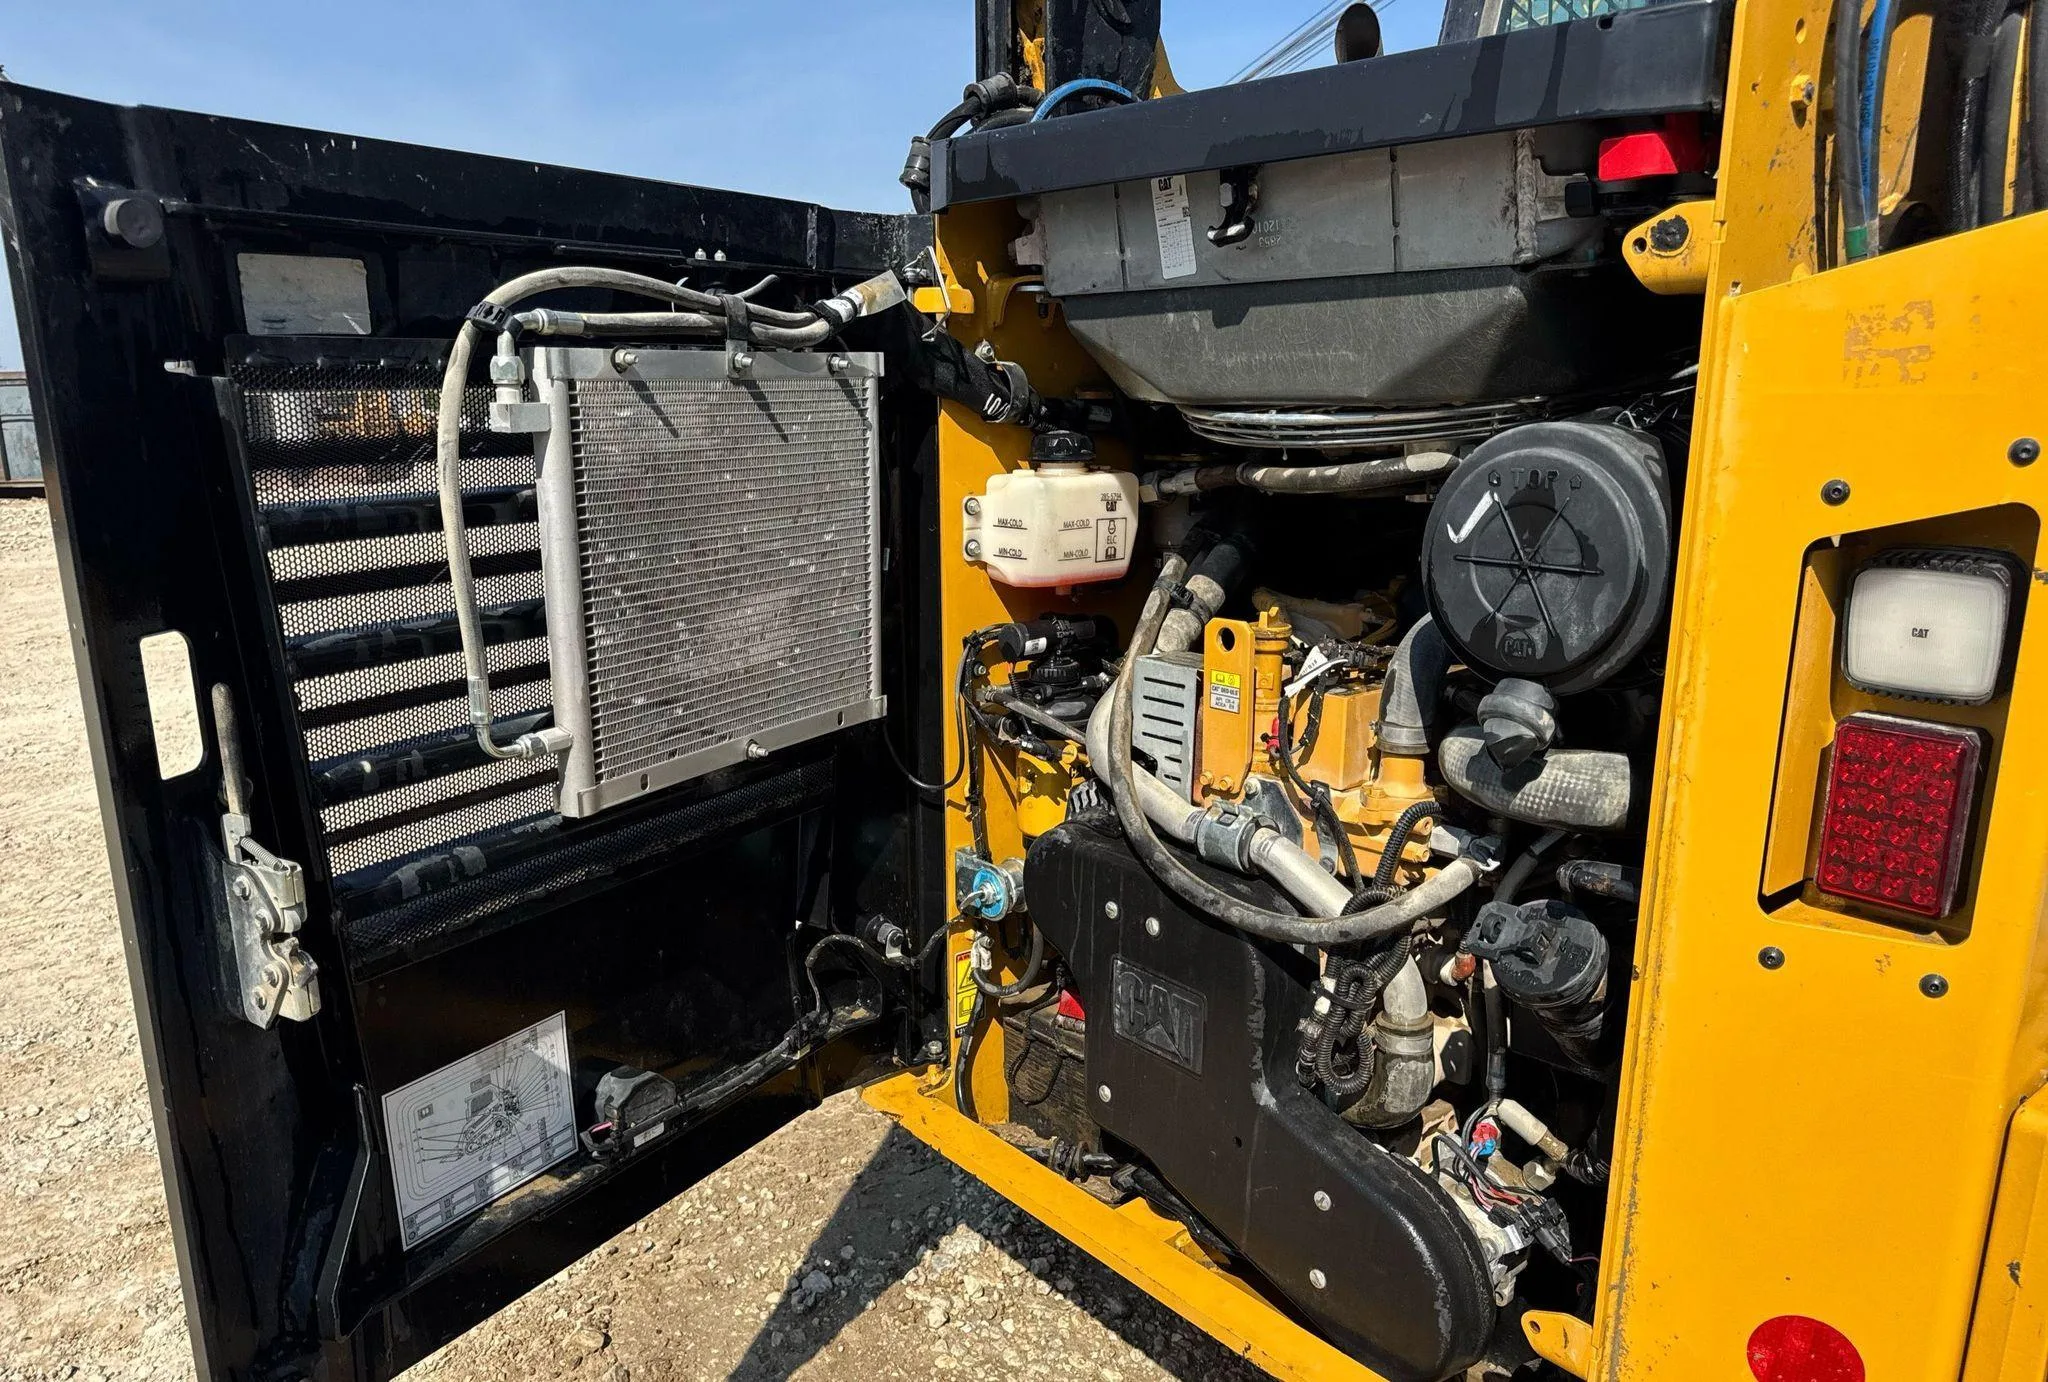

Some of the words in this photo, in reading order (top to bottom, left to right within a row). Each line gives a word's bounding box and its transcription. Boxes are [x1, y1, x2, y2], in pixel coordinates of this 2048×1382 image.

[1158, 176, 1173, 191] CAT
[1510, 468, 1560, 491] TOP
[1105, 501, 1117, 512] CAT
[997, 517, 1023, 528] MAX-COLD
[1063, 518, 1091, 529] MAX-COLD
[1106, 534, 1117, 545] ELC
[998, 547, 1022, 557] MIN-COLD
[1063, 548, 1089, 558] MIN-COLD
[1911, 627, 1929, 639] CAT
[1116, 971, 1200, 1068] CAT
